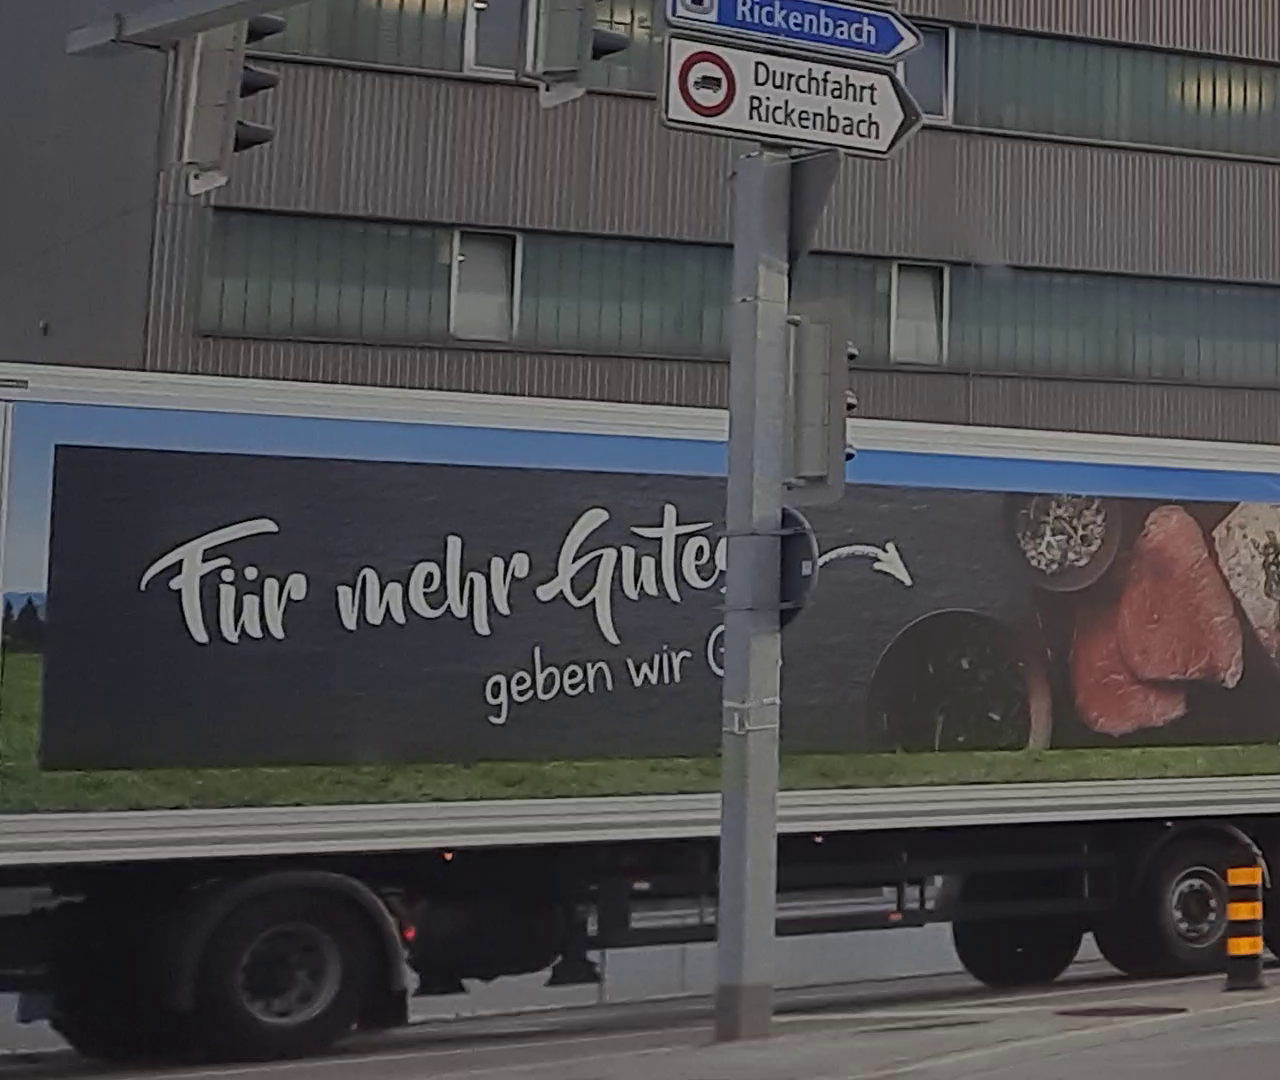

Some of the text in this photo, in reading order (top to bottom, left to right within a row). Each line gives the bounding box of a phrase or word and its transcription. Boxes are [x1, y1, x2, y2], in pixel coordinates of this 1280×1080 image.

[754, 60, 878, 106] Durchfahrt
[749, 95, 880, 140] Rickenbach
[140, 516, 308, 645] Für
[336, 534, 529, 638] mehr
[485, 646, 613, 726] geben
[626, 646, 694, 688] wir
